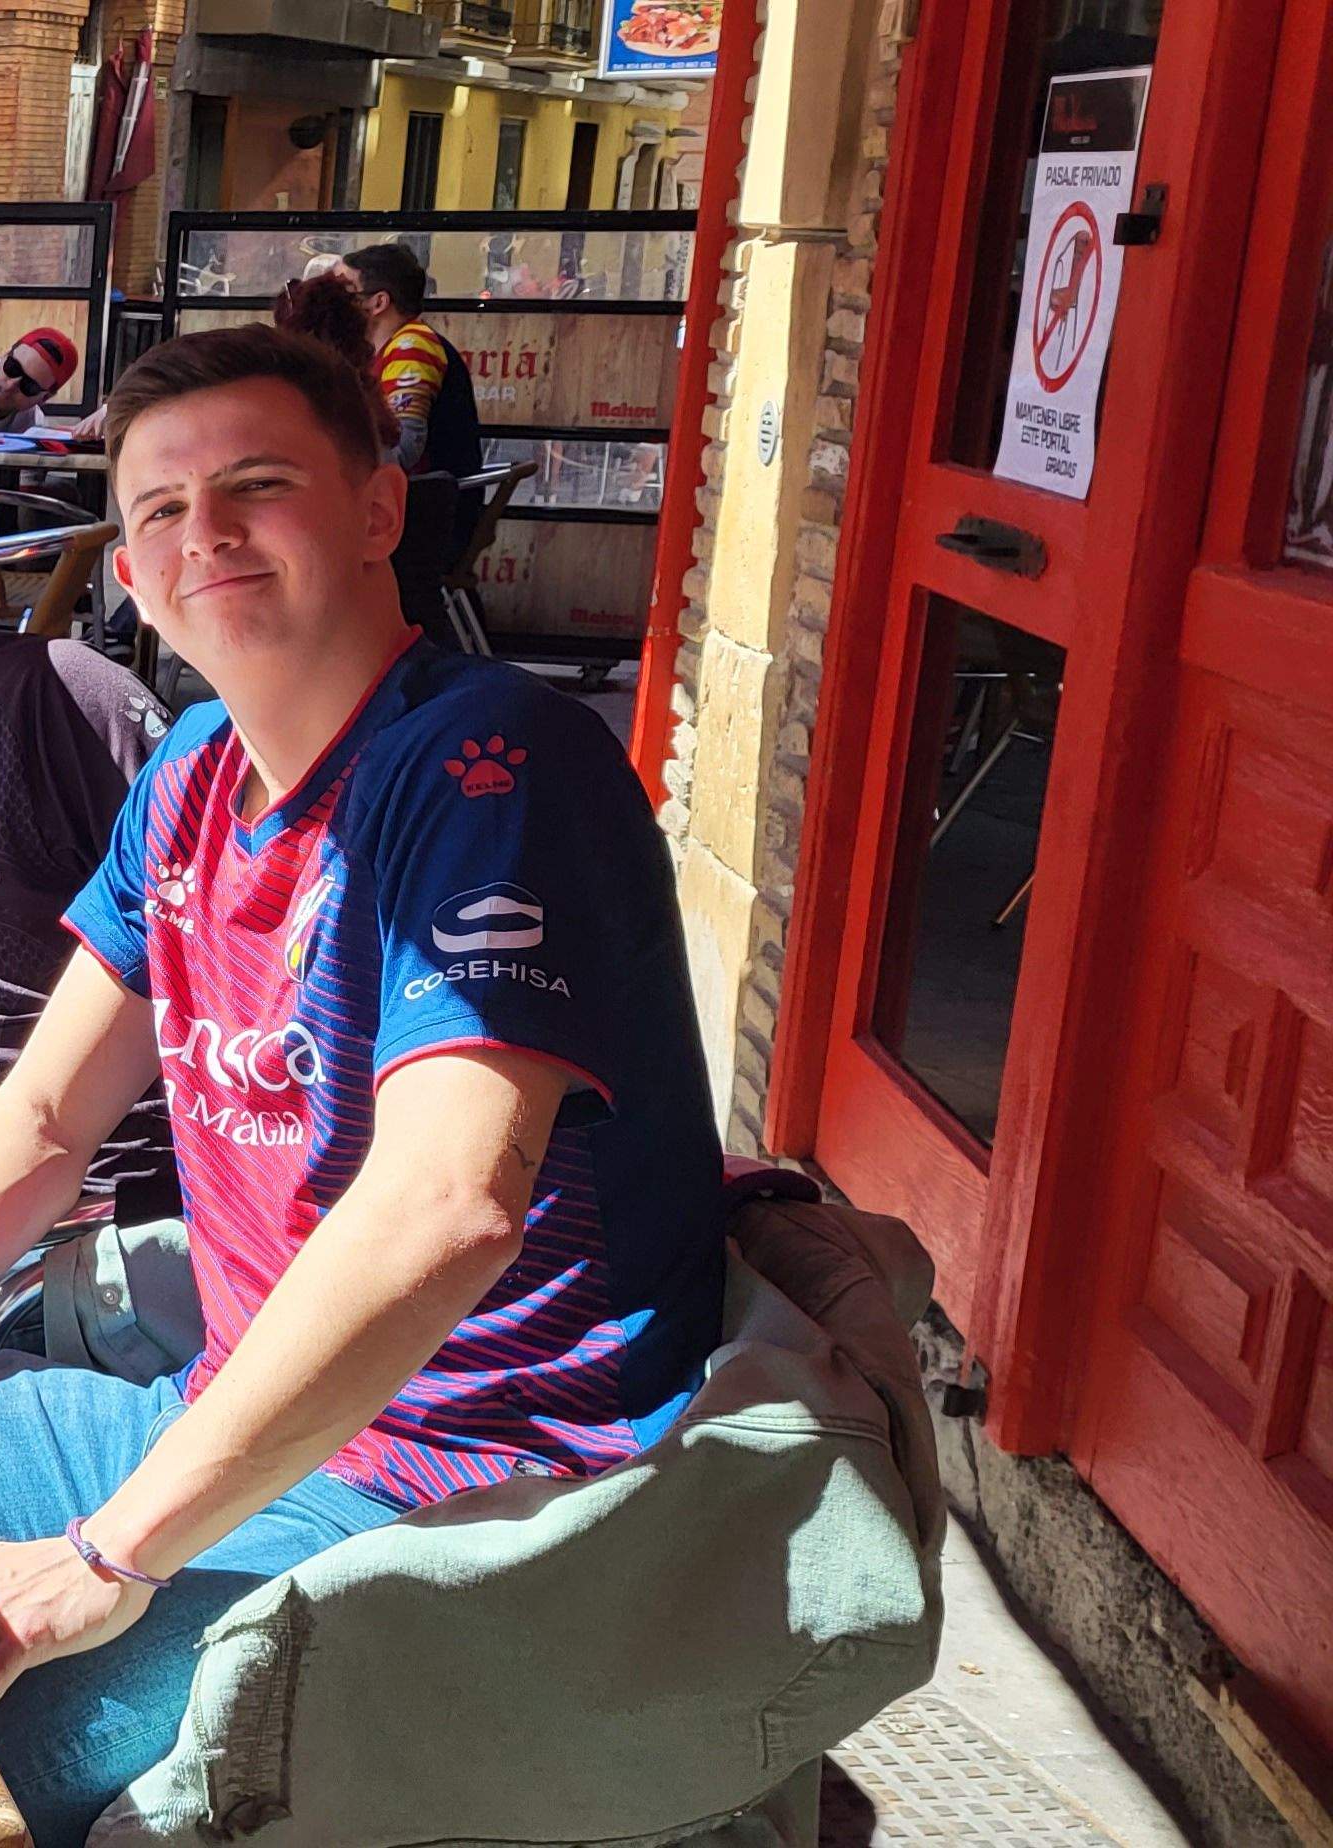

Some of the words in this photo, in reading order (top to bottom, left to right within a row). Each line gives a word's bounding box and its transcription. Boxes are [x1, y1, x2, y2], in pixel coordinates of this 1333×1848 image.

[1045, 166, 1080, 187] PASAJE
[1082, 165, 1122, 187] PRIVADO
[591, 402, 657, 419] Mahou
[1015, 401, 1058, 428] MANTENER
[1058, 412, 1081, 434] LIBRE
[1021, 425, 1040, 446] ESTE
[1041, 430, 1071, 454] PORTAL
[1045, 456, 1078, 478] GRACIAS
[144, 899, 195, 936] ELME
[403, 959, 572, 1001] COSEHISA
